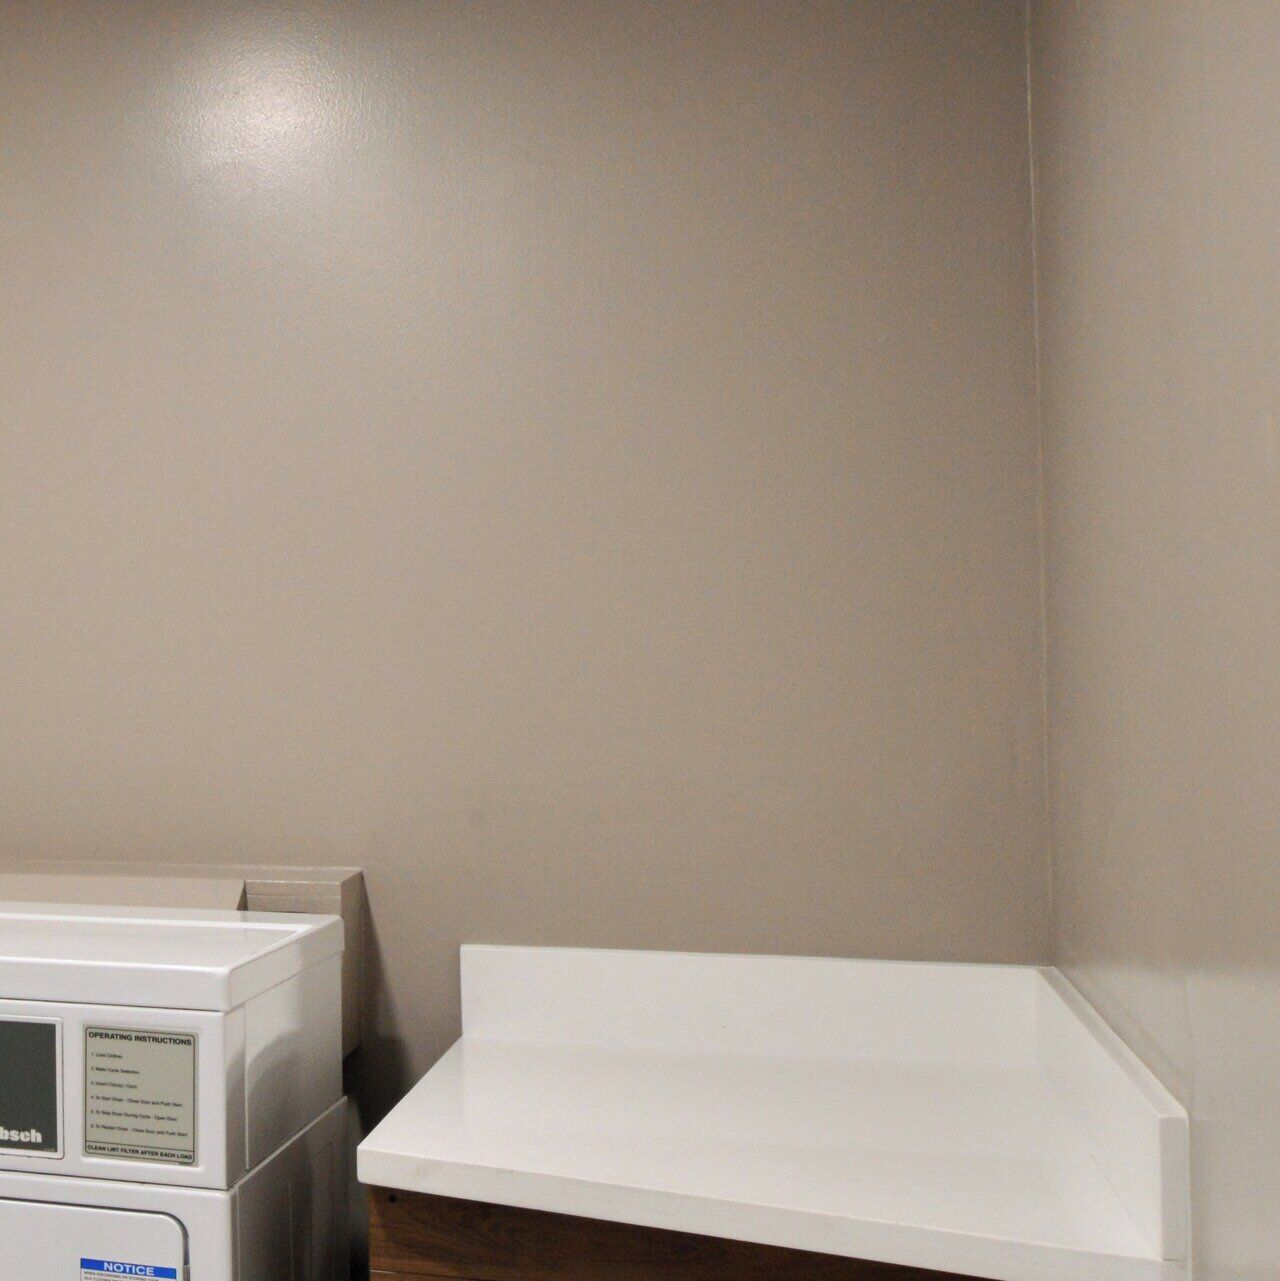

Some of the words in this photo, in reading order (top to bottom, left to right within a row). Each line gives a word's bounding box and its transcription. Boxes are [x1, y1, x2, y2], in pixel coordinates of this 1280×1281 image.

[88, 1031, 132, 1041] OPERATING
[134, 1035, 191, 1045] INSTRUCTIONS
[104, 1262, 154, 1275] NOTICE
